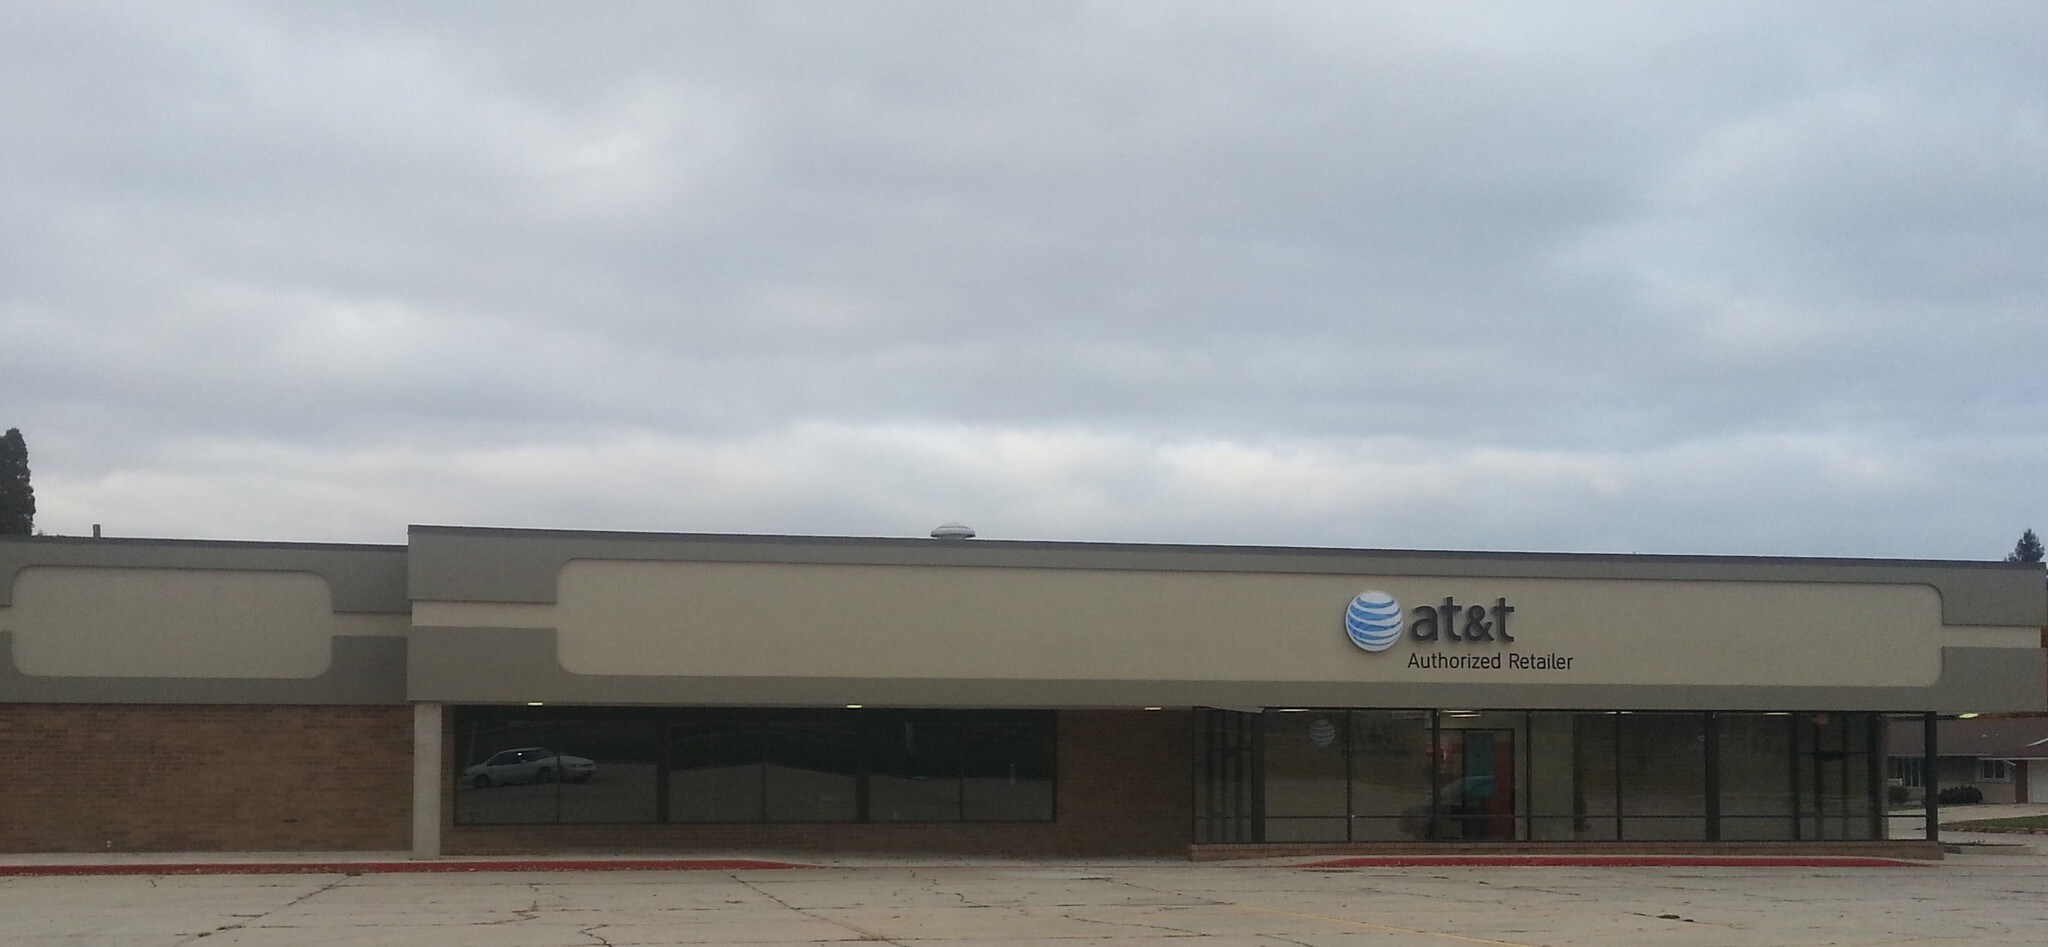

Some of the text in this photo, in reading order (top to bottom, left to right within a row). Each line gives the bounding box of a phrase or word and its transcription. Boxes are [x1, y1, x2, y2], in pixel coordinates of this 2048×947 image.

[1409, 596, 1515, 643] at&t
[1407, 652, 1574, 670] Authorized Retailer
